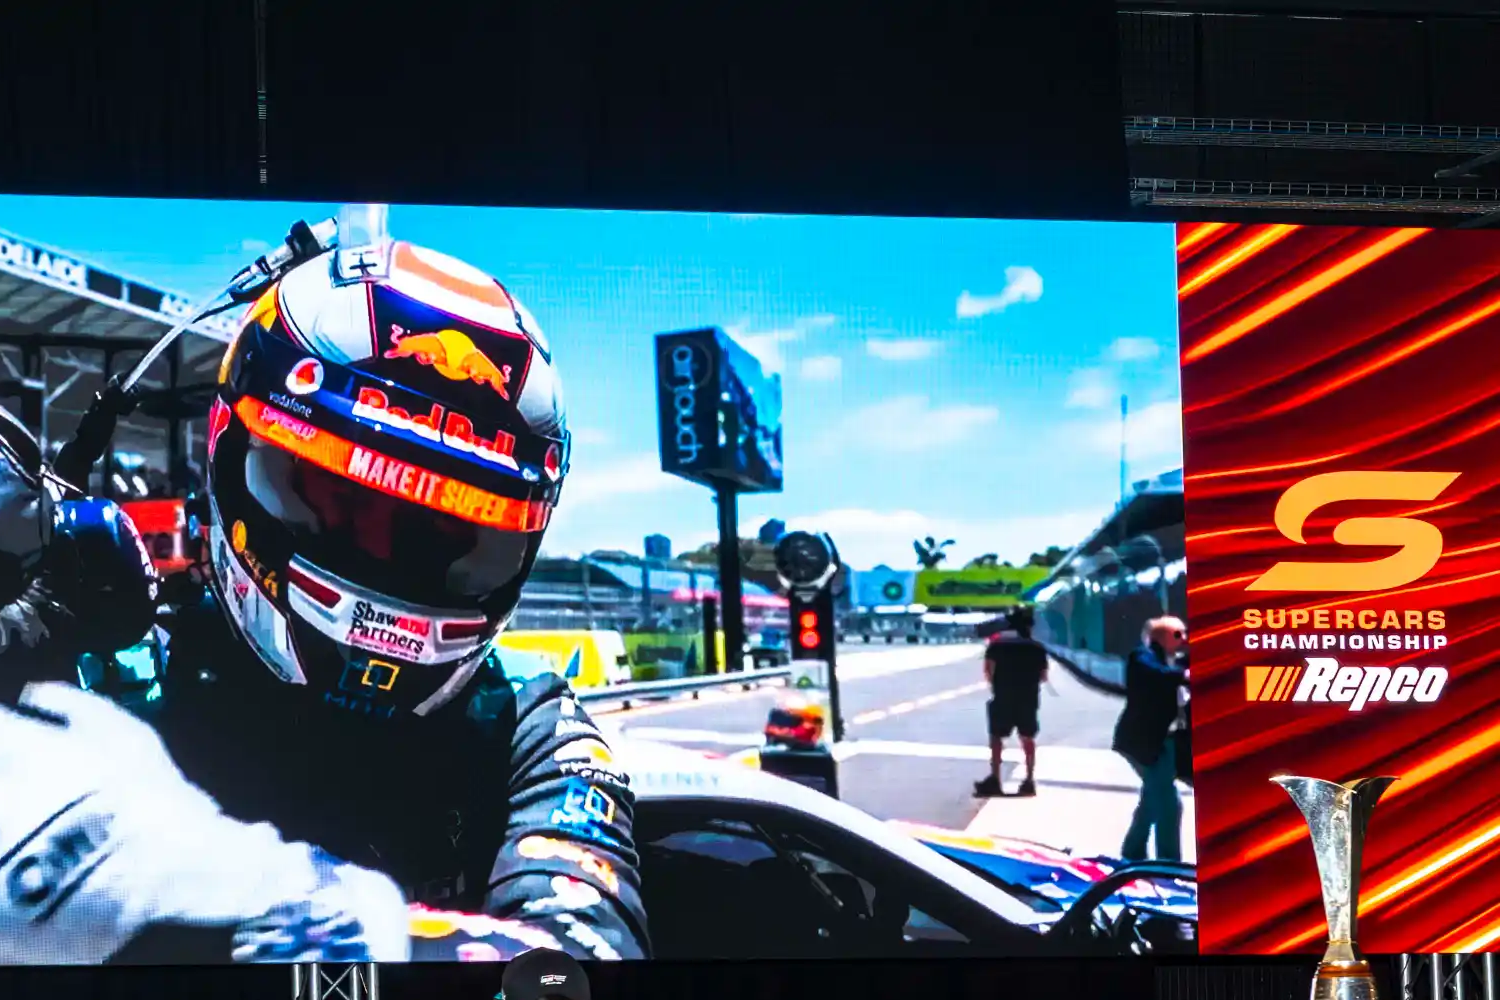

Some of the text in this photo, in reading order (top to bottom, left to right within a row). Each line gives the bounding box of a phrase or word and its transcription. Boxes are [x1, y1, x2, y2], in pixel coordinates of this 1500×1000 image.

[348, 447, 416, 496] MAKE
[414, 469, 441, 503] IT
[349, 616, 424, 654] Partners
[1243, 608, 1446, 630] SUPERCARS
[1243, 634, 1448, 650] CHAMPIONSHIP
[1292, 657, 1449, 711] Repco
